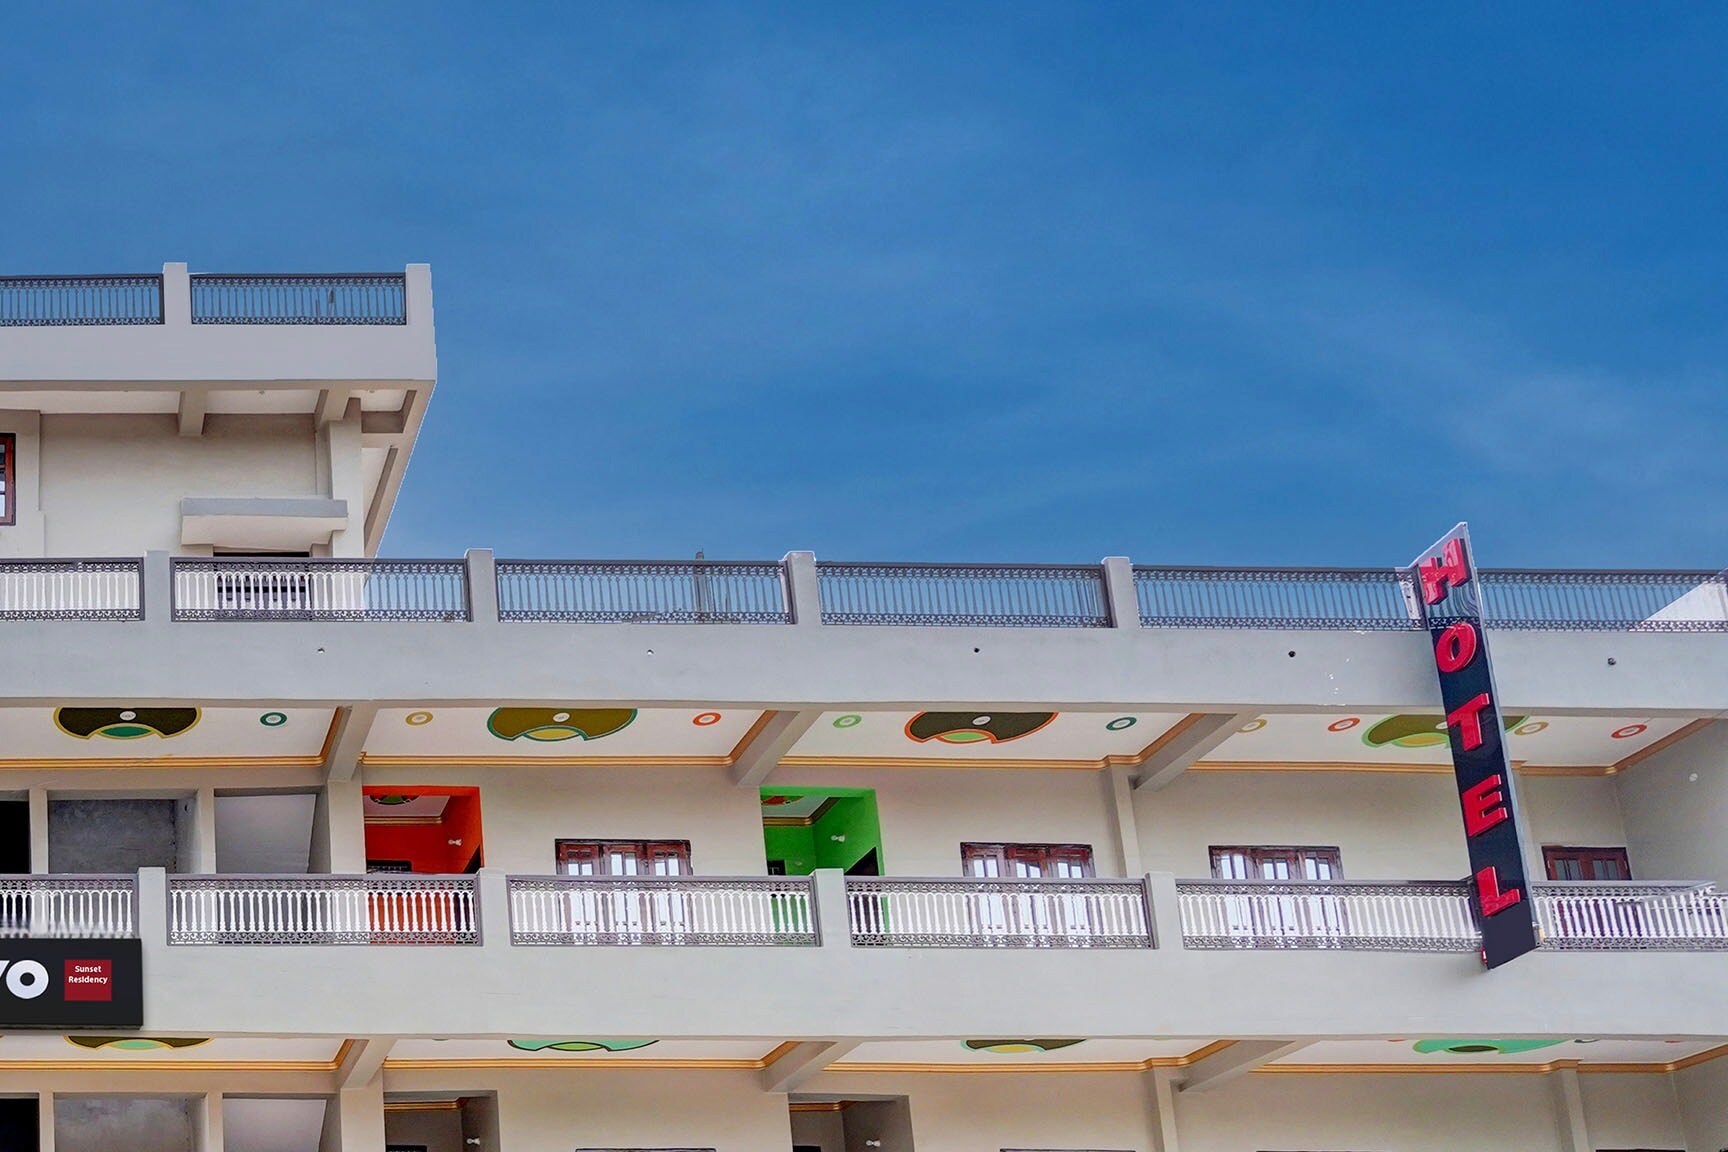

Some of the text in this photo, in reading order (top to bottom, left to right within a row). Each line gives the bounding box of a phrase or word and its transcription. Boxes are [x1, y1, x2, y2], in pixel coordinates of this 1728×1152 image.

[1418, 537, 1521, 917] HOTEL
[74, 965, 102, 973] Sunset
[68, 975, 108, 985] Residency
